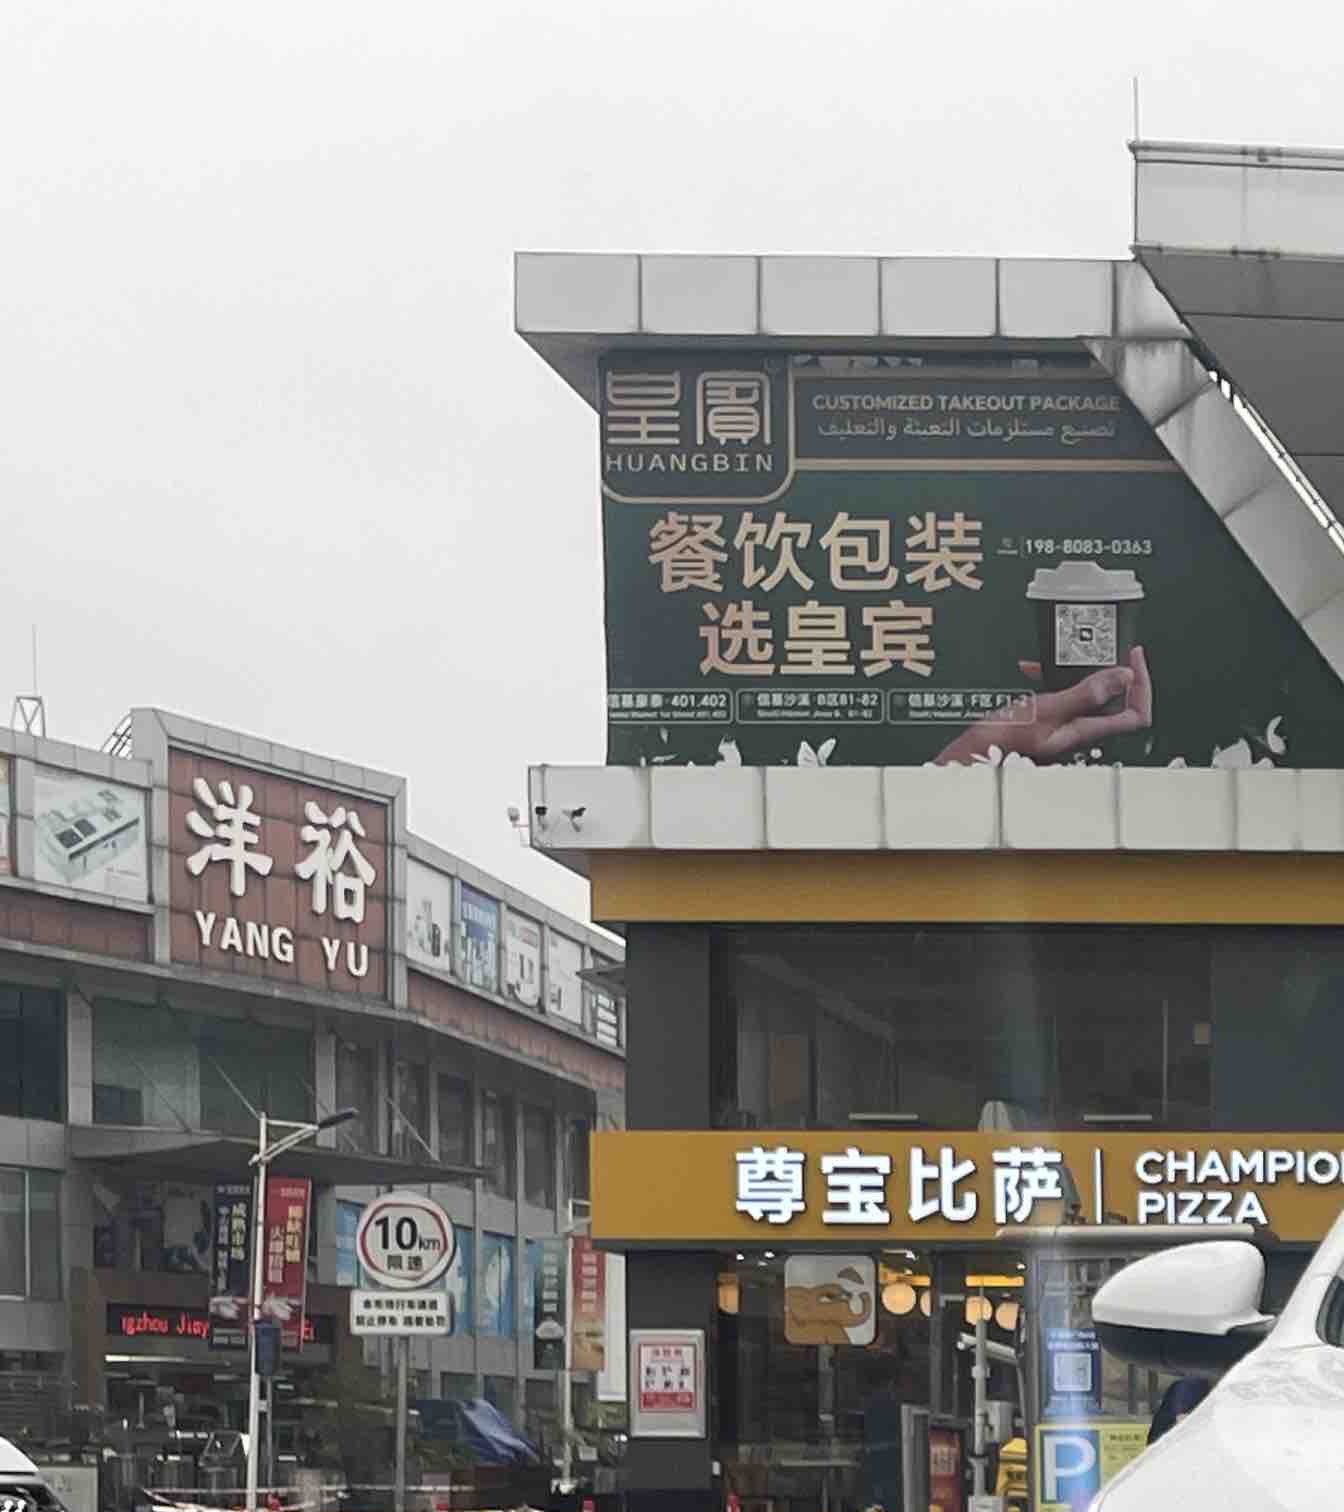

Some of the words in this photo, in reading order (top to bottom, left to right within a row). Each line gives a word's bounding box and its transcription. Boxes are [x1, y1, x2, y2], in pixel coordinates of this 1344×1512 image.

[811, 395, 933, 411] CUSTOMIZED
[938, 395, 1024, 411] TAKEOUT
[1026, 395, 1120, 411] PACKAGE
[606, 454, 773, 472] HUANGBIN
[647, 512, 984, 594] 餐饮包装
[699, 600, 936, 678] 选皇宾
[186, 777, 377, 924] 洋裕
[195, 911, 294, 964] YANG
[321, 937, 368, 977] YU
[735, 1146, 1062, 1225] 尊宝比萨
[1136, 1191, 1268, 1225] PIZZA
